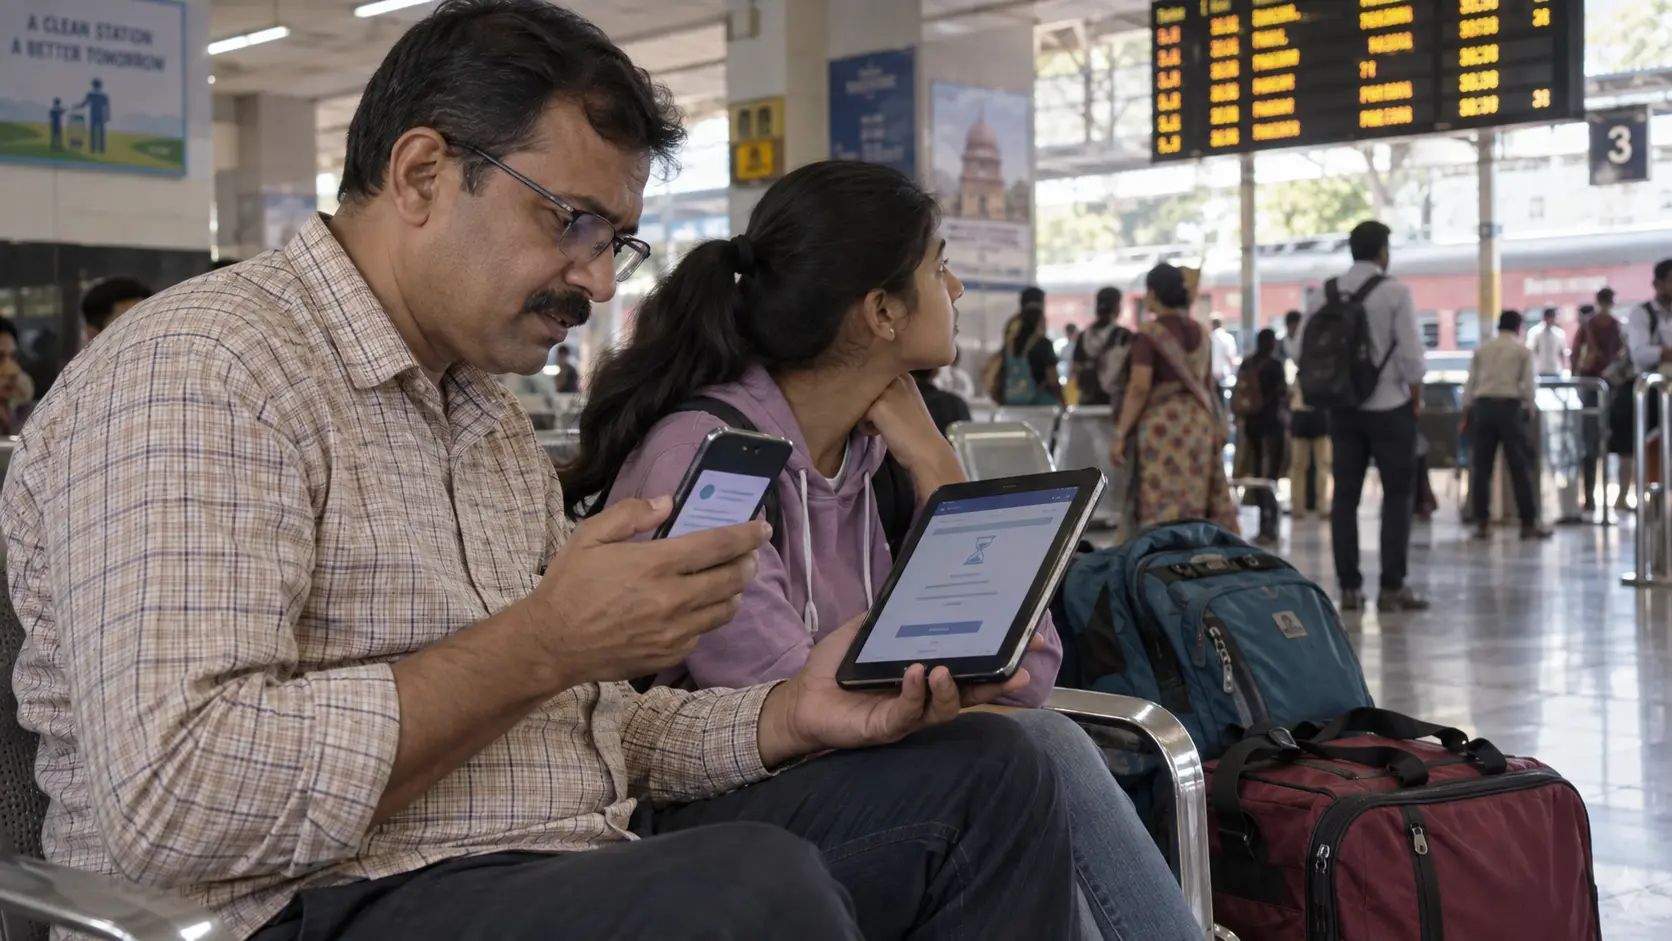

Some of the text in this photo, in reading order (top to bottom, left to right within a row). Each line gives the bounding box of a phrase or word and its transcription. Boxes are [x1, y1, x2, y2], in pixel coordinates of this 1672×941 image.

[27, 14, 153, 46] A CLEAN STATION
[11, 36, 165, 72] A BETTER TOMORROW
[1608, 125, 1632, 164] 3
